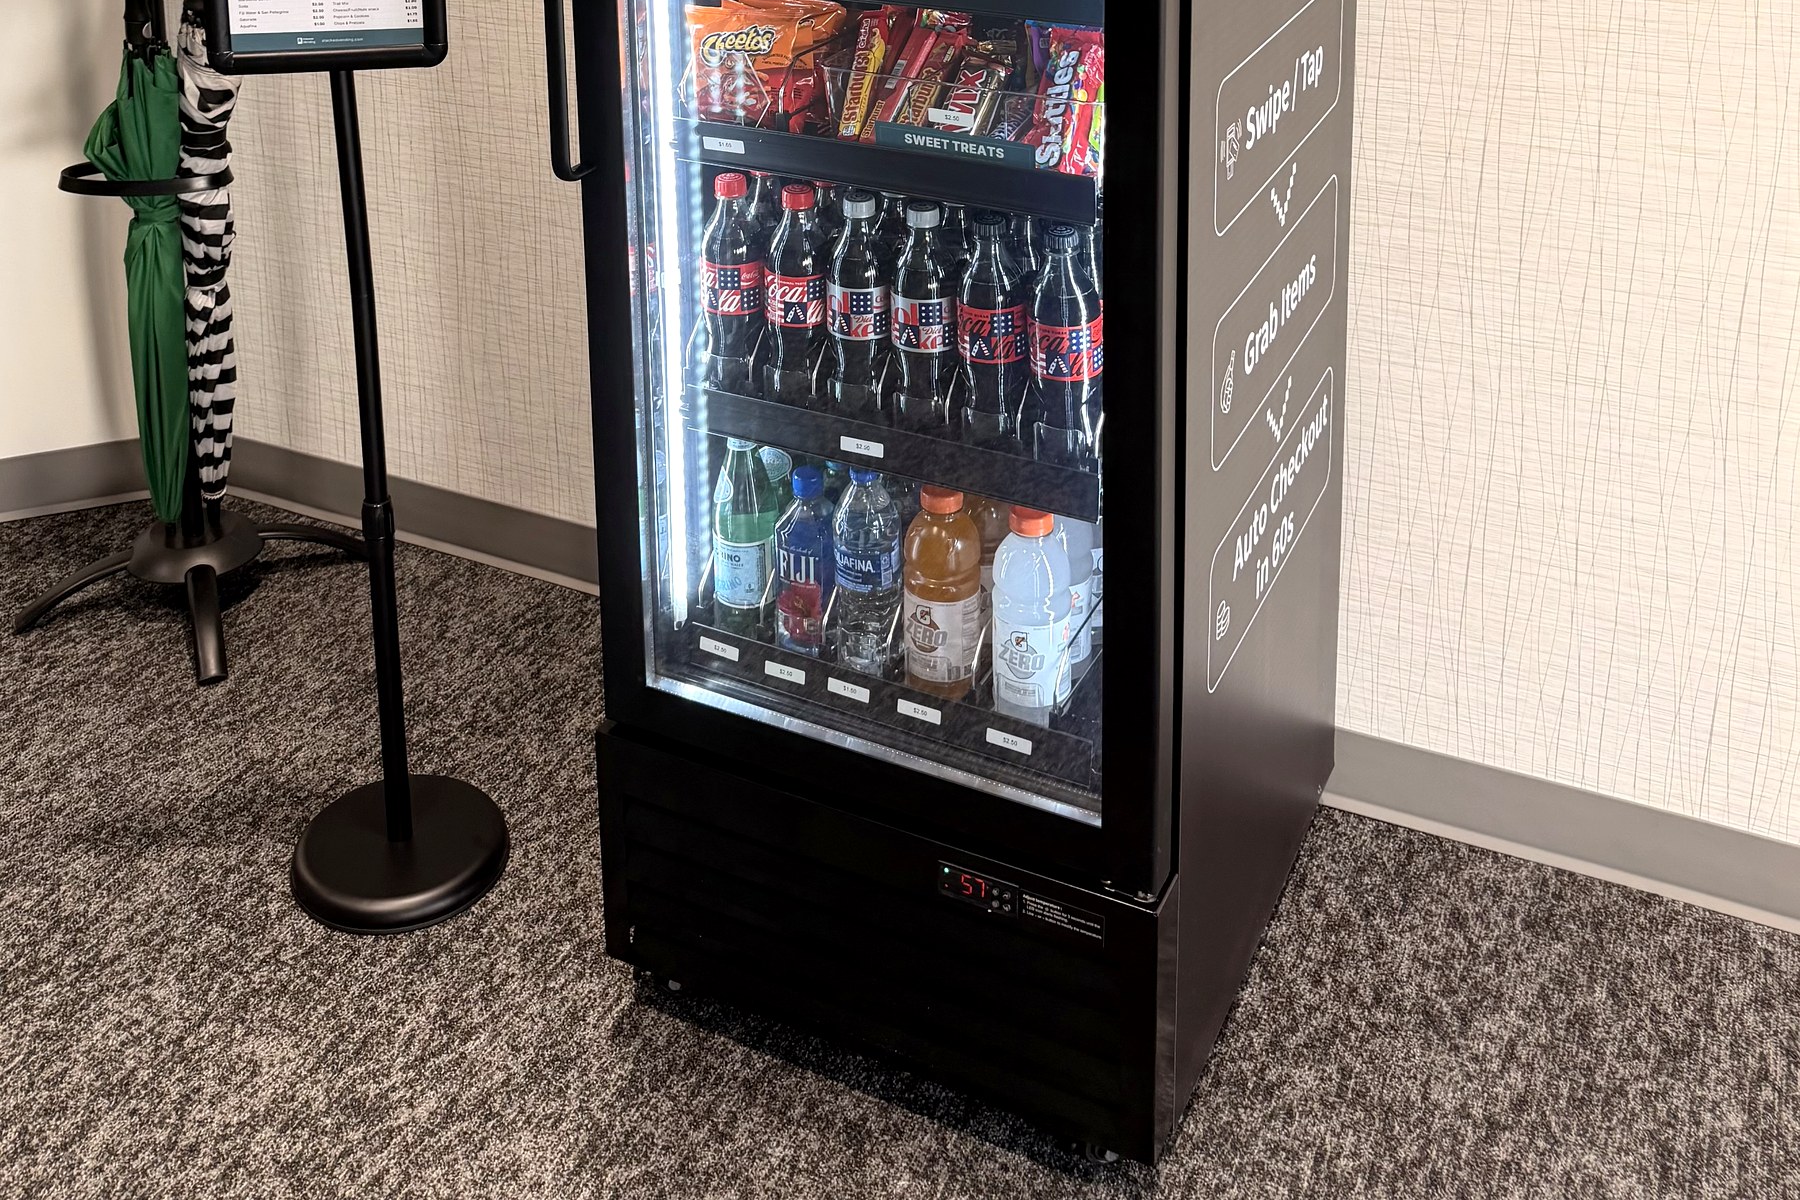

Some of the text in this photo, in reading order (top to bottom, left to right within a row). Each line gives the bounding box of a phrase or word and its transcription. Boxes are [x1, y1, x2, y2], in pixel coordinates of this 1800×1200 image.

[700, 25, 776, 68] Cheetos
[842, 50, 870, 124] Starburst
[1245, 45, 1324, 150] Swipe / Tap
[861, 99, 886, 138] Starburst
[944, 114, 960, 122] $2.50
[1035, 50, 1081, 167] Skittles
[904, 132, 1004, 159] SWEET TREATS
[922, 326, 943, 335] Diet
[1244, 254, 1317, 375] Grab Items
[1232, 394, 1328, 582] Auto Checkout
[779, 548, 815, 585] FIJI
[1255, 511, 1295, 600] in 60s
[905, 617, 948, 647] ZERO
[779, 668, 793, 677] $2.50
[998, 645, 1046, 671] ZERO
[1002, 736, 1018, 746] $2.50
[960, 873, 985, 898] 57
